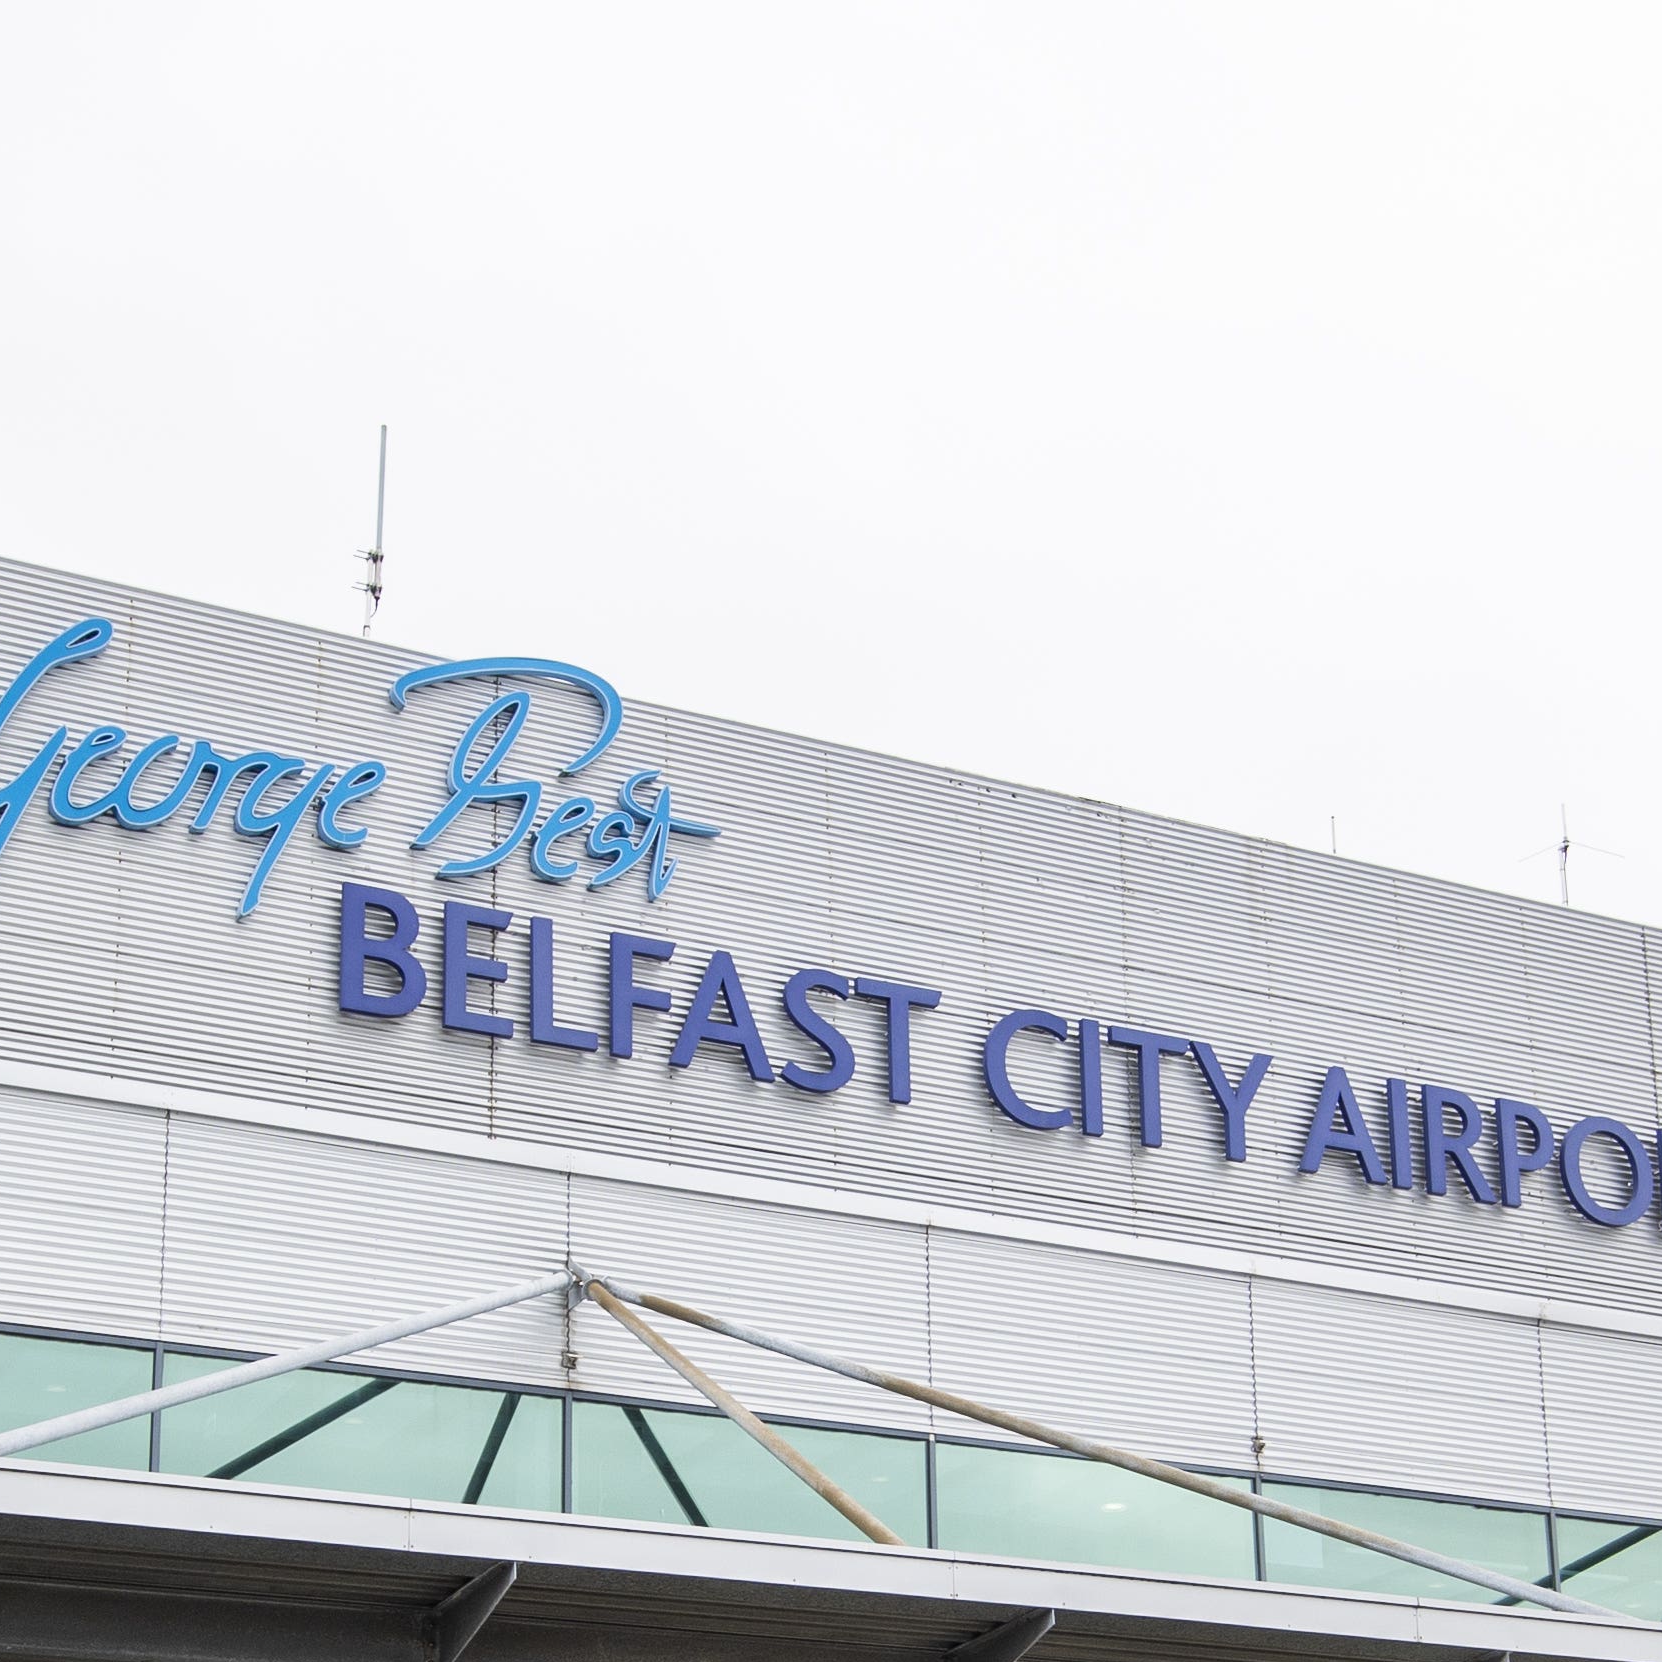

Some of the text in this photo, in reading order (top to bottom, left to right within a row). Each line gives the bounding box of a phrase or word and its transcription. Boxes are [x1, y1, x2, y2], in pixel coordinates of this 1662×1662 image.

[389, 657, 722, 902] Best
[338, 881, 943, 1105] BELFAST
[983, 1008, 1273, 1163] CITY
